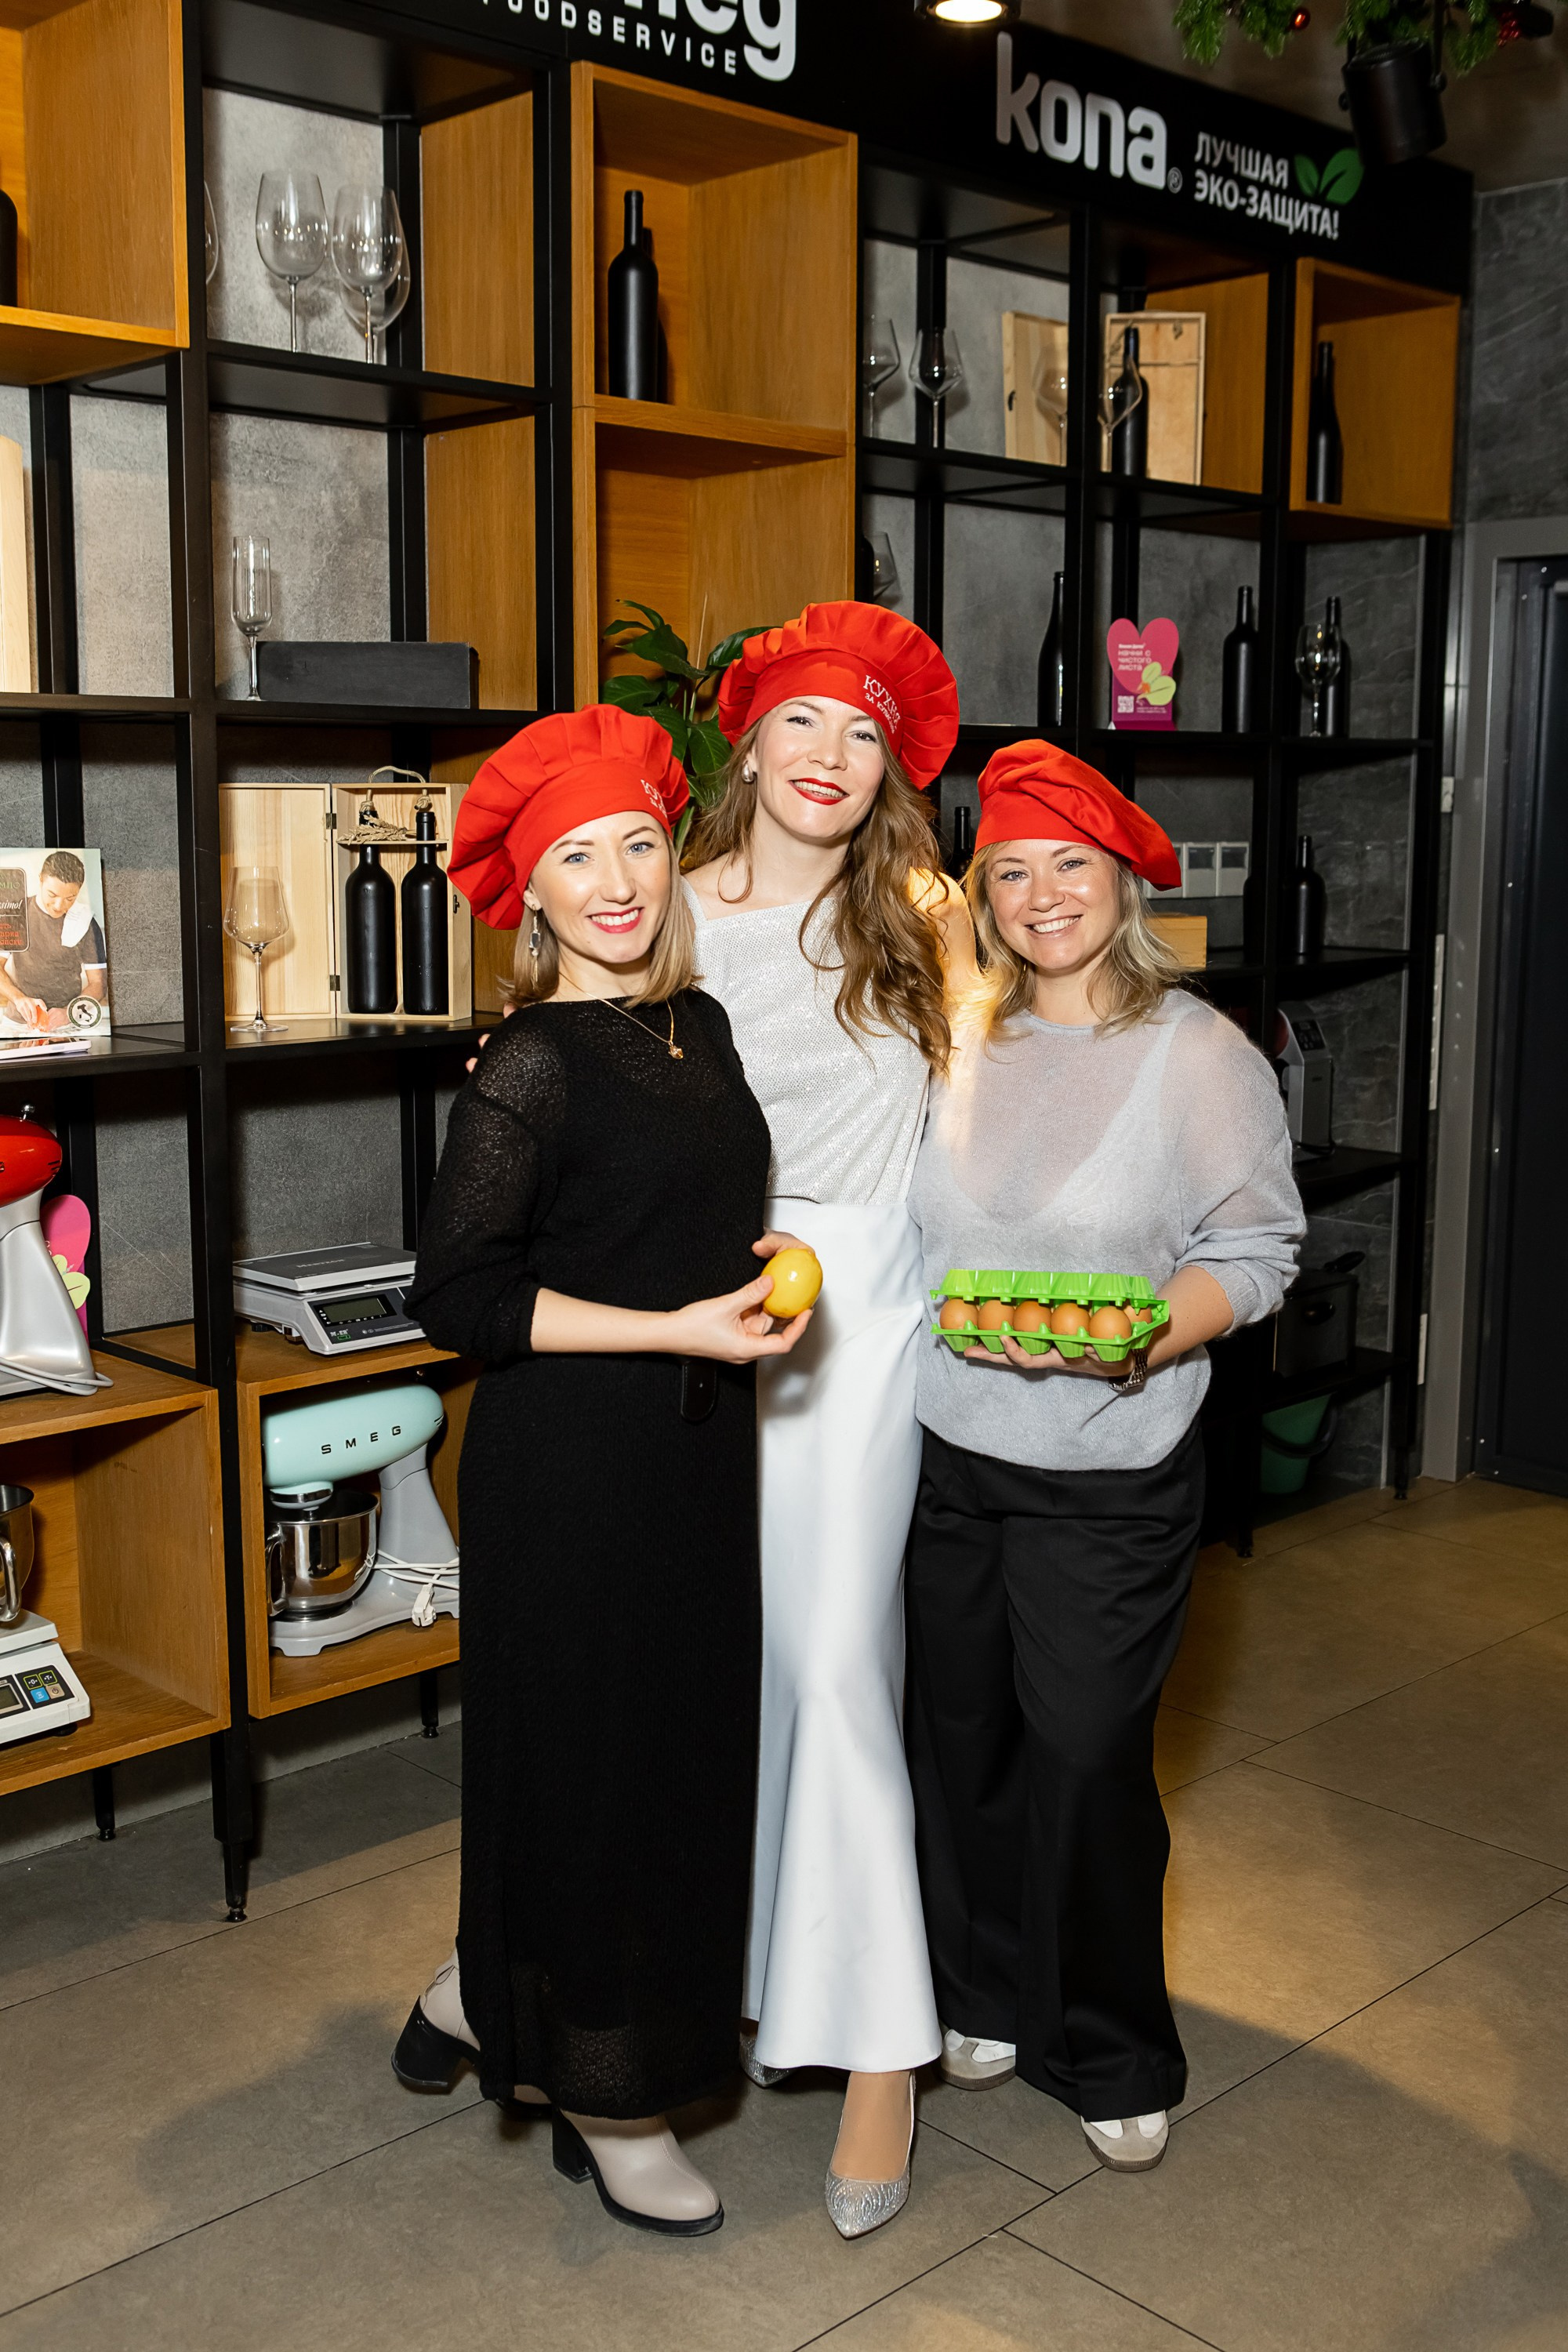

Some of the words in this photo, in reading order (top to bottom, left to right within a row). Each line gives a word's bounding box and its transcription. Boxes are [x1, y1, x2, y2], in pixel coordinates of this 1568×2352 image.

[483, 0, 737, 75] OODSERVICE
[996, 31, 1167, 190] kona
[1194, 131, 1290, 190] ЛУЧШАЯ
[1194, 170, 1340, 240] ЭКО-ЗАЩИТА!
[0, 899, 23, 909] simo!
[321, 1425, 401, 1455] SMEG
